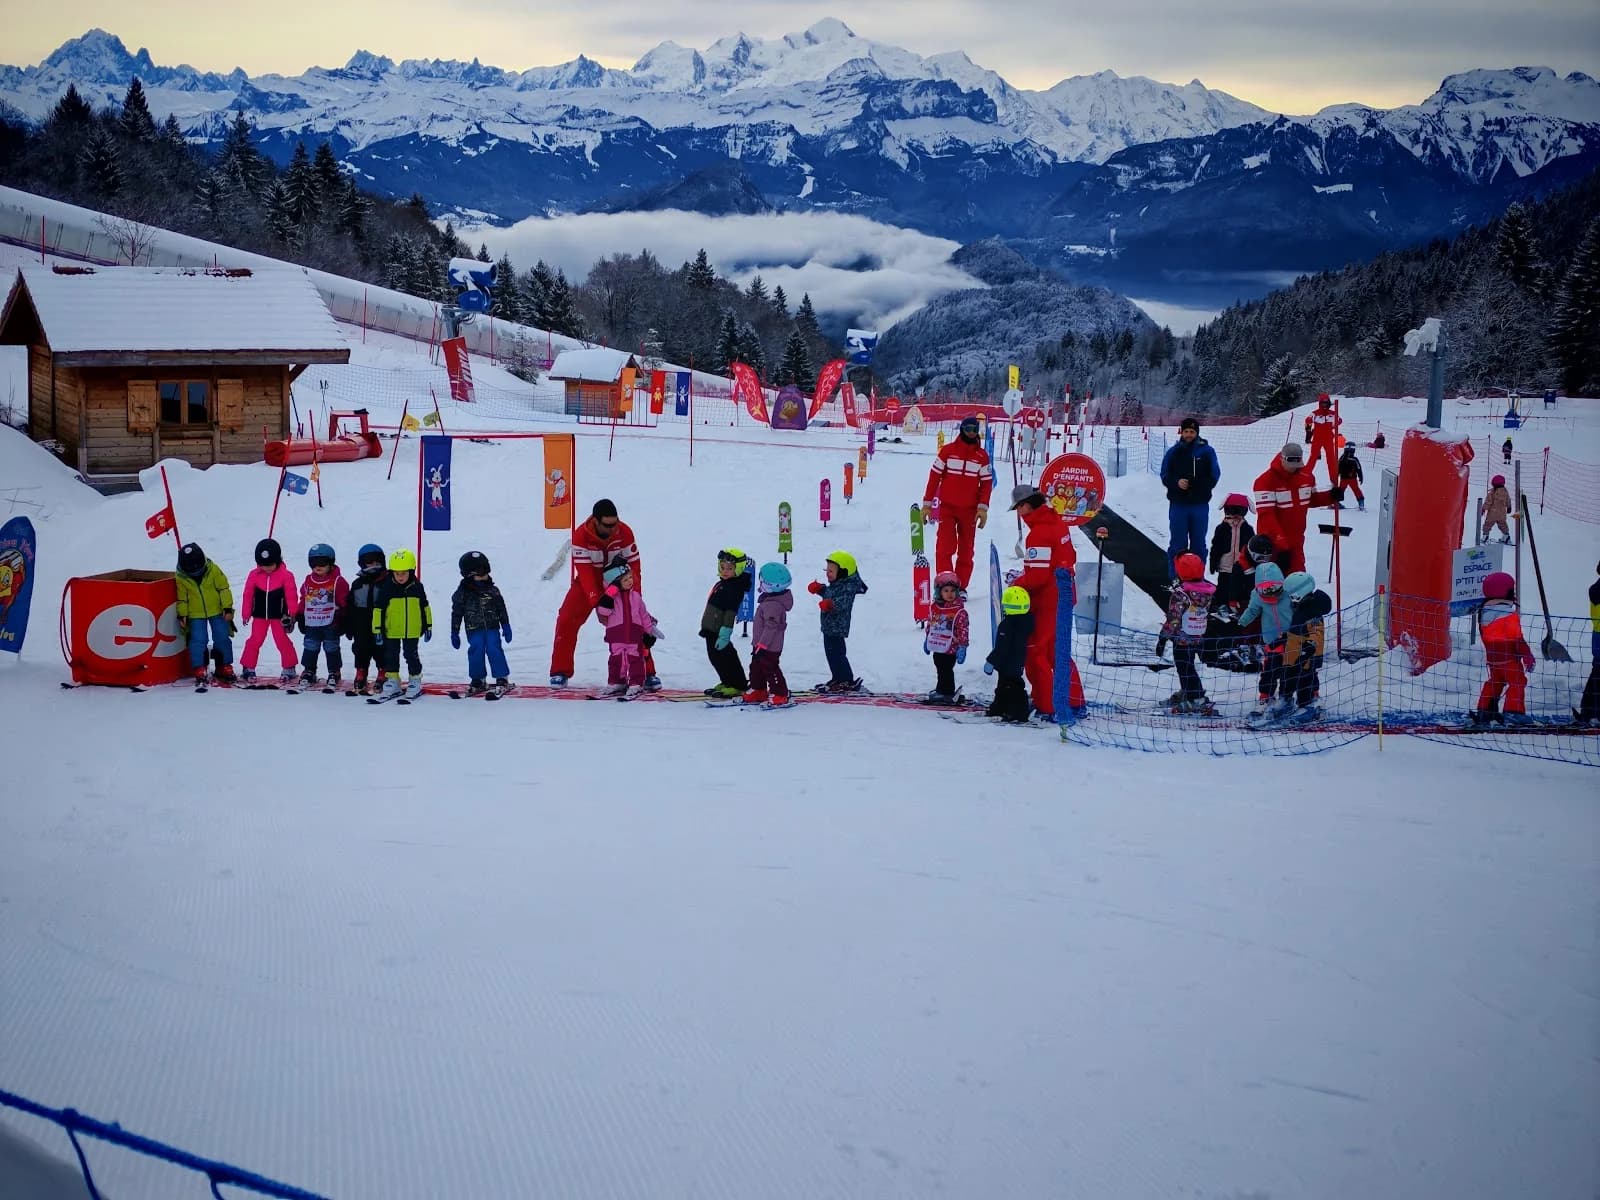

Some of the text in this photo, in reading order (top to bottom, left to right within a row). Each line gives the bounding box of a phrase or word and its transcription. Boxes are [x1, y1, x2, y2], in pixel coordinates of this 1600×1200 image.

[1060, 466, 1089, 475] JARDIN
[1053, 472, 1094, 483] D'ENFANTS
[931, 496, 940, 509] 3
[910, 522, 920, 537] 2
[1463, 562, 1493, 574] ESPACE
[1455, 576, 1474, 587] P'TIT
[919, 579, 930, 604] 1
